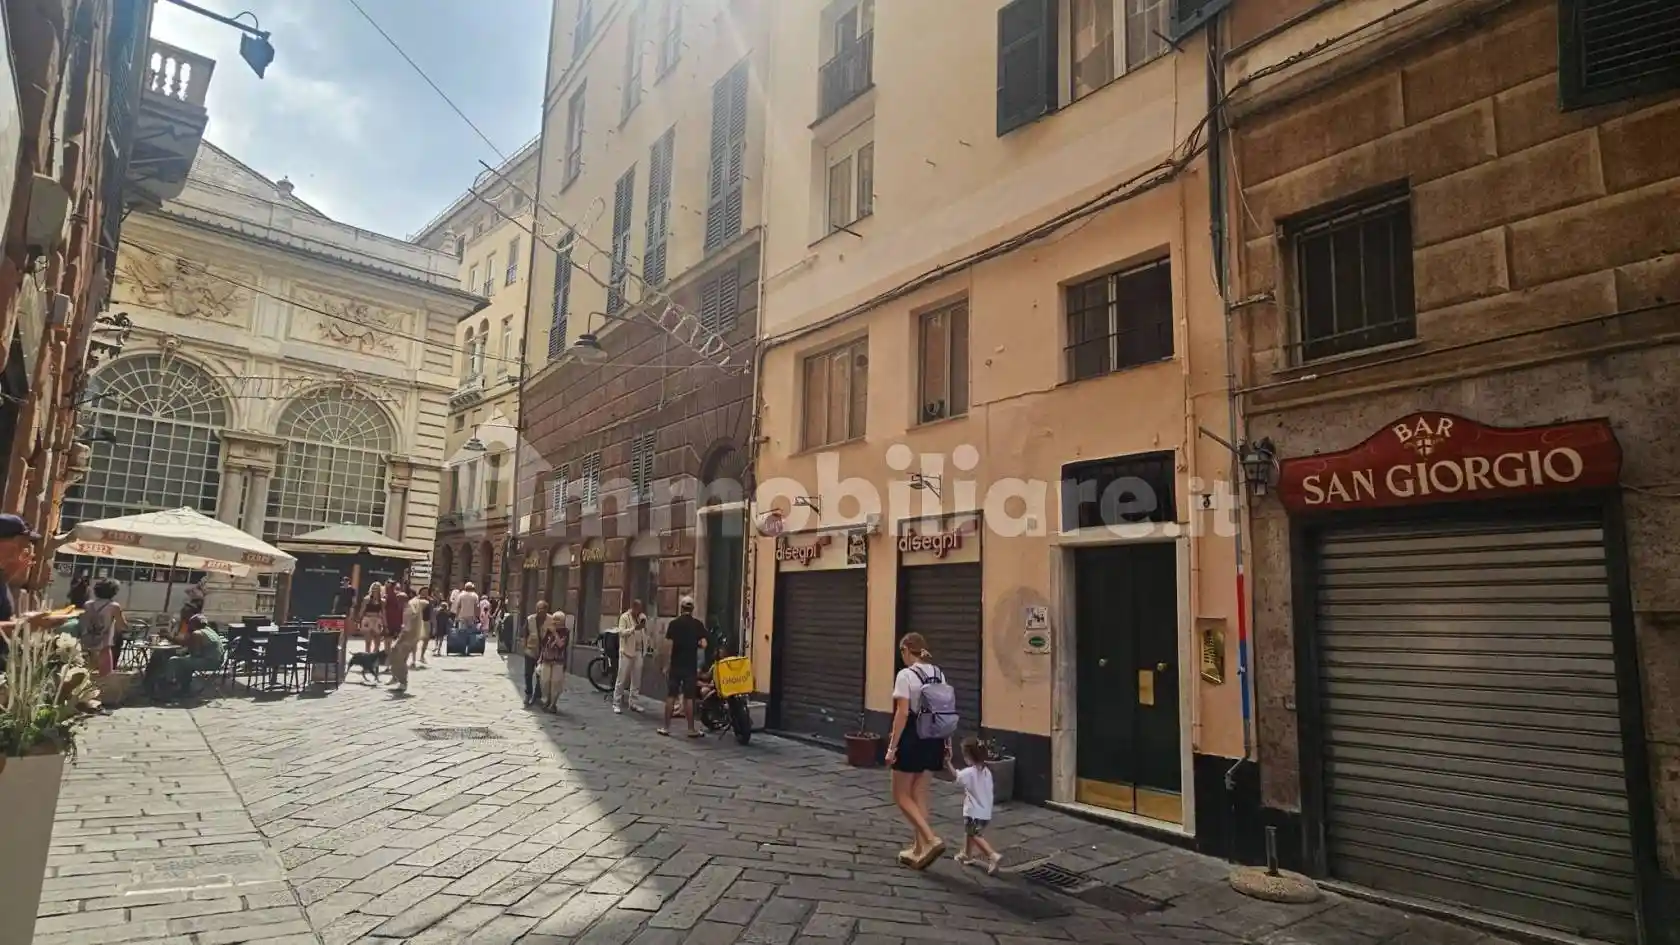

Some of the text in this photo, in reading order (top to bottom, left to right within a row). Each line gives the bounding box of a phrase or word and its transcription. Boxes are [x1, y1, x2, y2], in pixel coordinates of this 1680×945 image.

[1393, 417, 1454, 443] BAR
[1302, 447, 1584, 504] SAN GIORGIO
[898, 528, 958, 558] disegni
